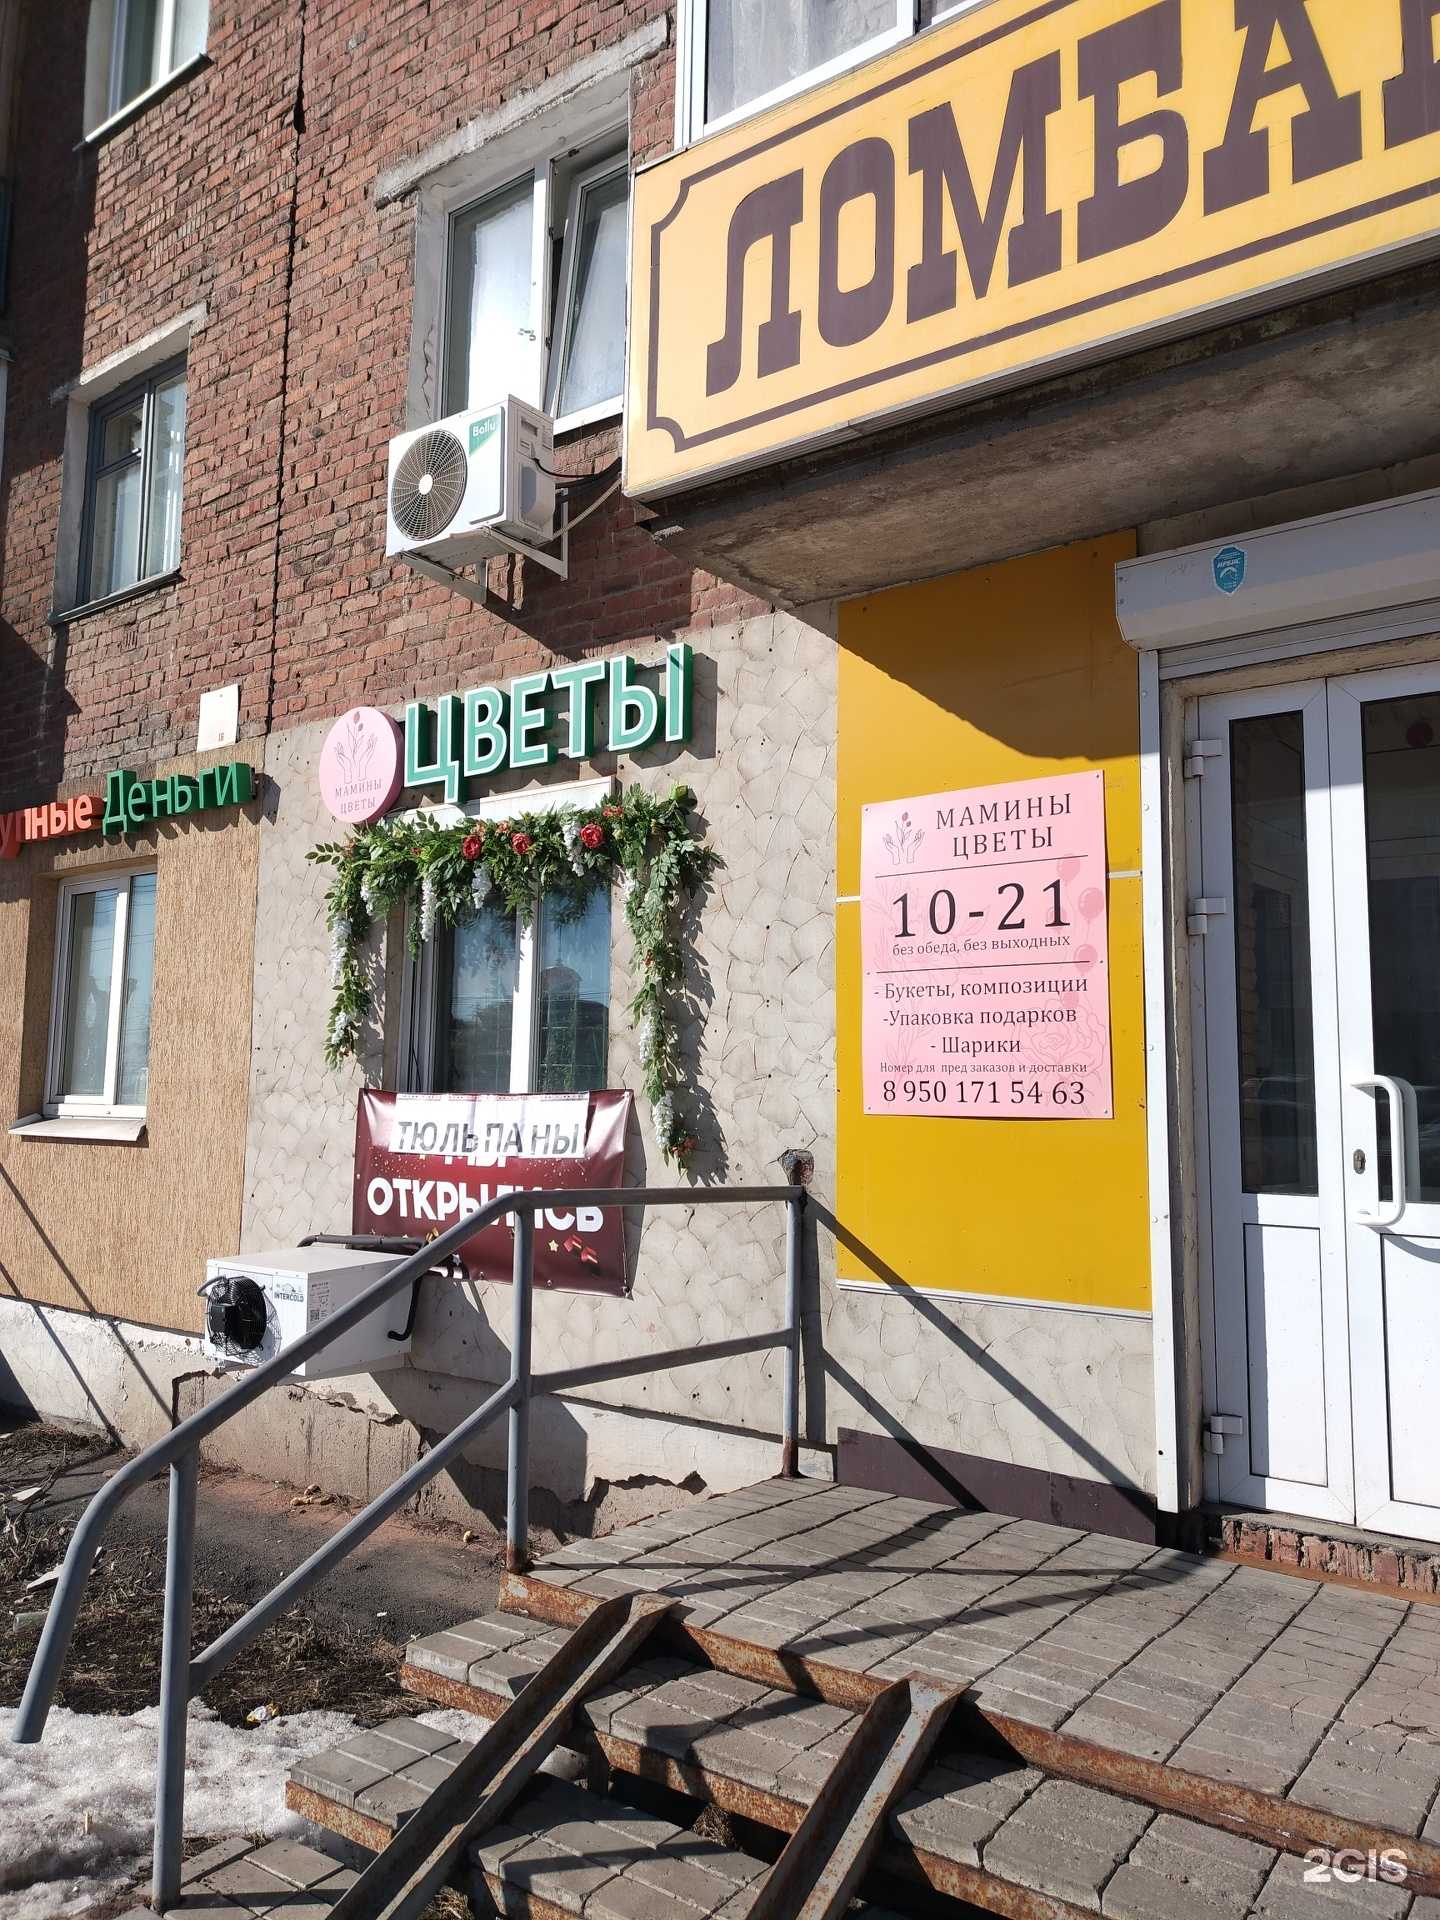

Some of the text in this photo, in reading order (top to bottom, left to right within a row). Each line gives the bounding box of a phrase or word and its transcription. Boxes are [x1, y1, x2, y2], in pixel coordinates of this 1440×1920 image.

[472, 419, 496, 437] Ballu
[404, 643, 688, 803] ЦВЕТЫ
[102, 762, 240, 836] Деньги
[335, 778, 382, 798] МАМИНЫ
[340, 797, 376, 815] ЦВЕТЫ
[936, 793, 1072, 830] МАМИНЫ
[953, 826, 1053, 860] ЦВЕТЫ
[892, 879, 1071, 938] 10-21
[892, 936, 1071, 957] без обеда, без выходных
[885, 983, 955, 1003] Букеты,
[960, 978, 1088, 998] композиции
[883, 1008, 1077, 1028] -Упаковка подарков
[942, 1036, 1021, 1057] Шарики
[880, 1062, 1088, 1075] Номер для пред заказов и доставки
[883, 1080, 1085, 1105] 8 950 171 54 63
[397, 1121, 580, 1155] ТЮЛЬПАНЫ
[274, 1292, 305, 1303] INTERCOLD
